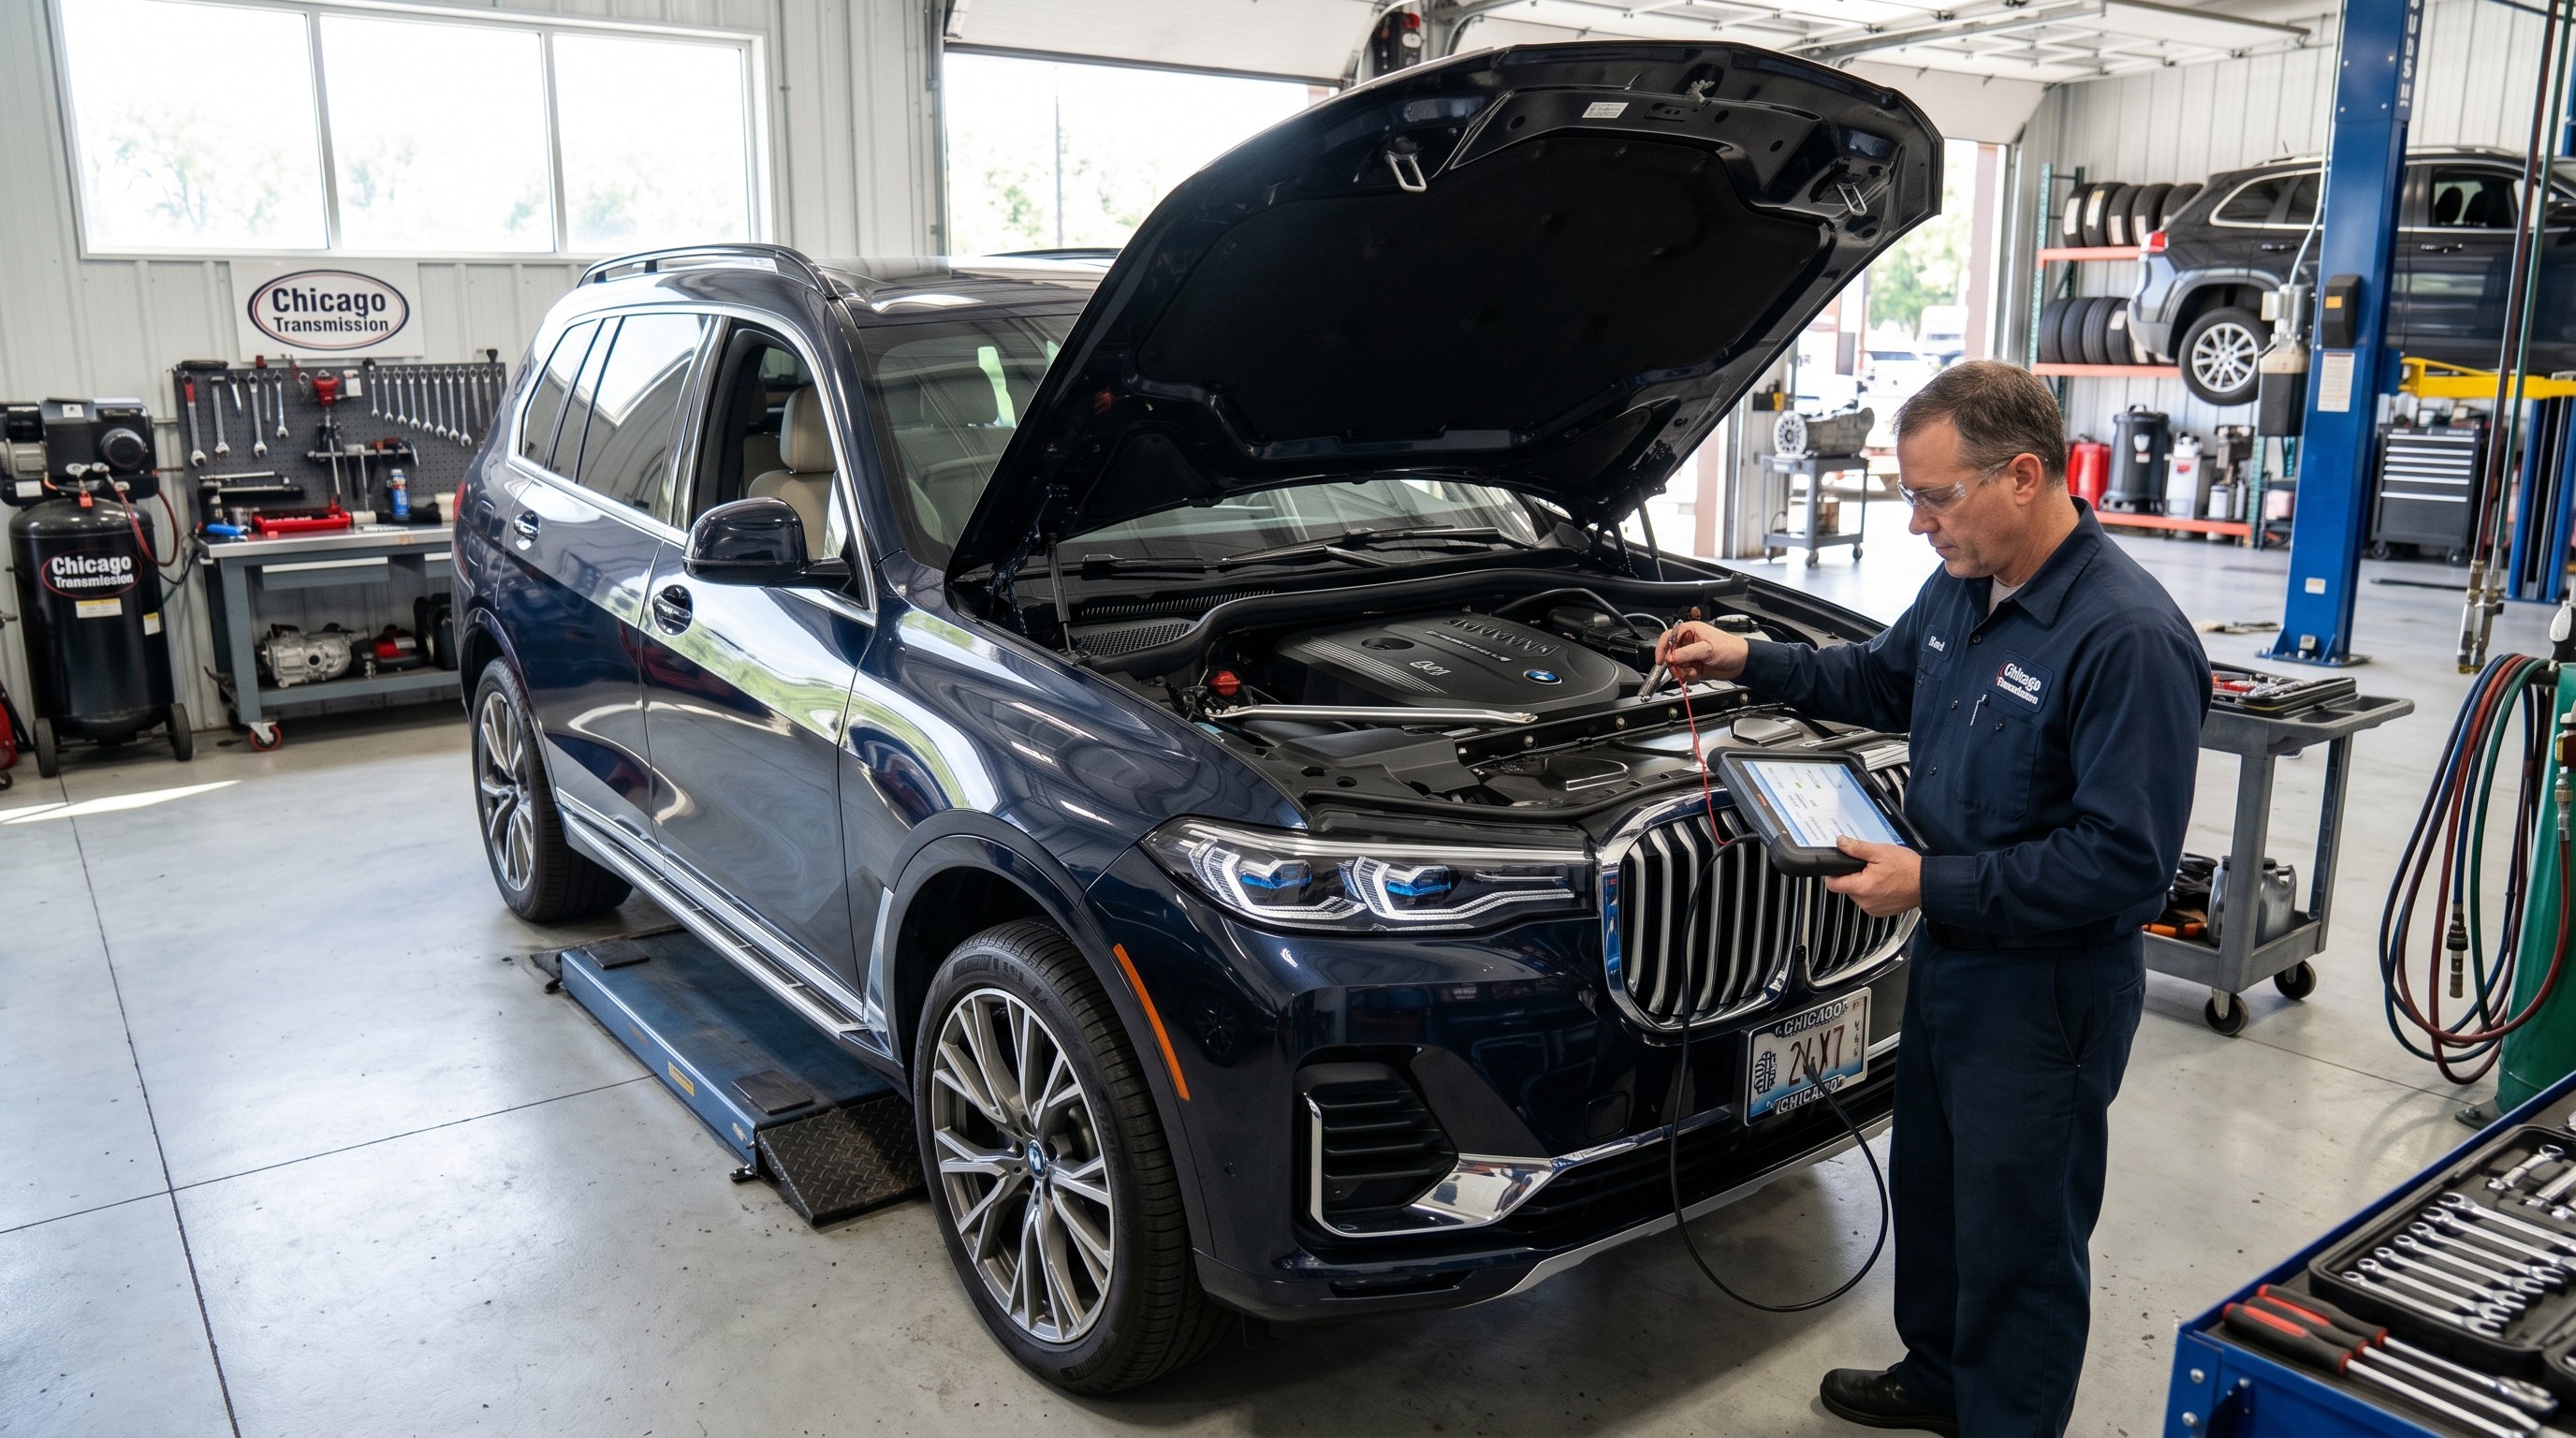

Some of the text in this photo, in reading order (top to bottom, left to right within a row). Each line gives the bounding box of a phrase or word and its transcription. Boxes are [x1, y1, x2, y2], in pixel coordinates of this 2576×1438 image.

[272, 287, 386, 317] Chicago
[273, 316, 388, 332] Transmission
[51, 555, 132, 575] Chicago
